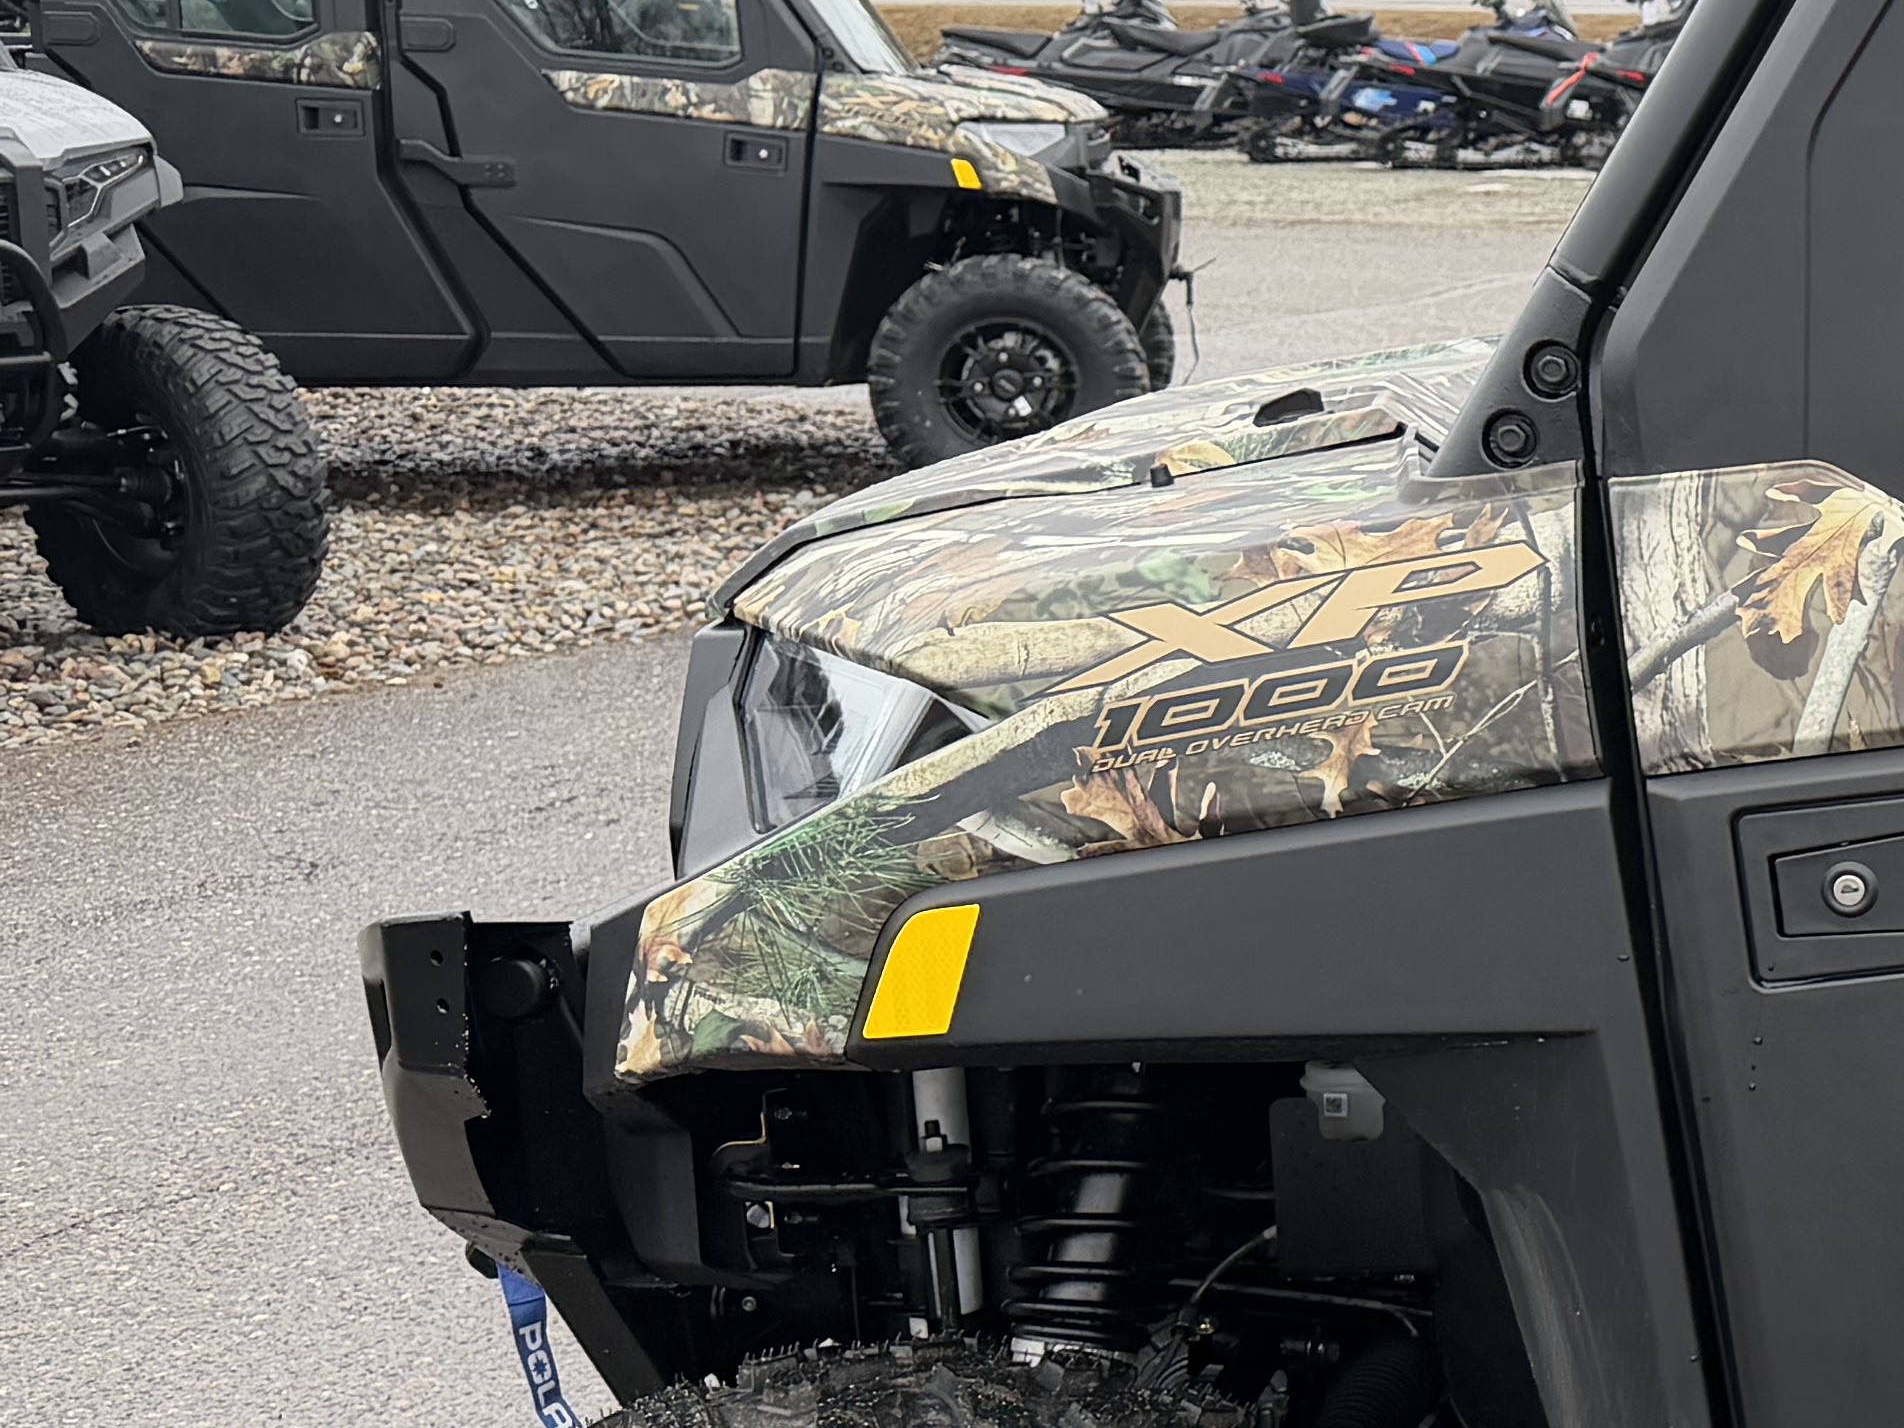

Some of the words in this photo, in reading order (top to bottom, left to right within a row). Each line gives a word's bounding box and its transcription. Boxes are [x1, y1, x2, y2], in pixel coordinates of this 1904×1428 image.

[1040, 542, 1548, 695] XP
[1092, 745, 1176, 773] DUAL
[1184, 708, 1371, 754] OVERHEAD
[1376, 695, 1455, 723] CAM
[1095, 641, 1470, 751] 1000
